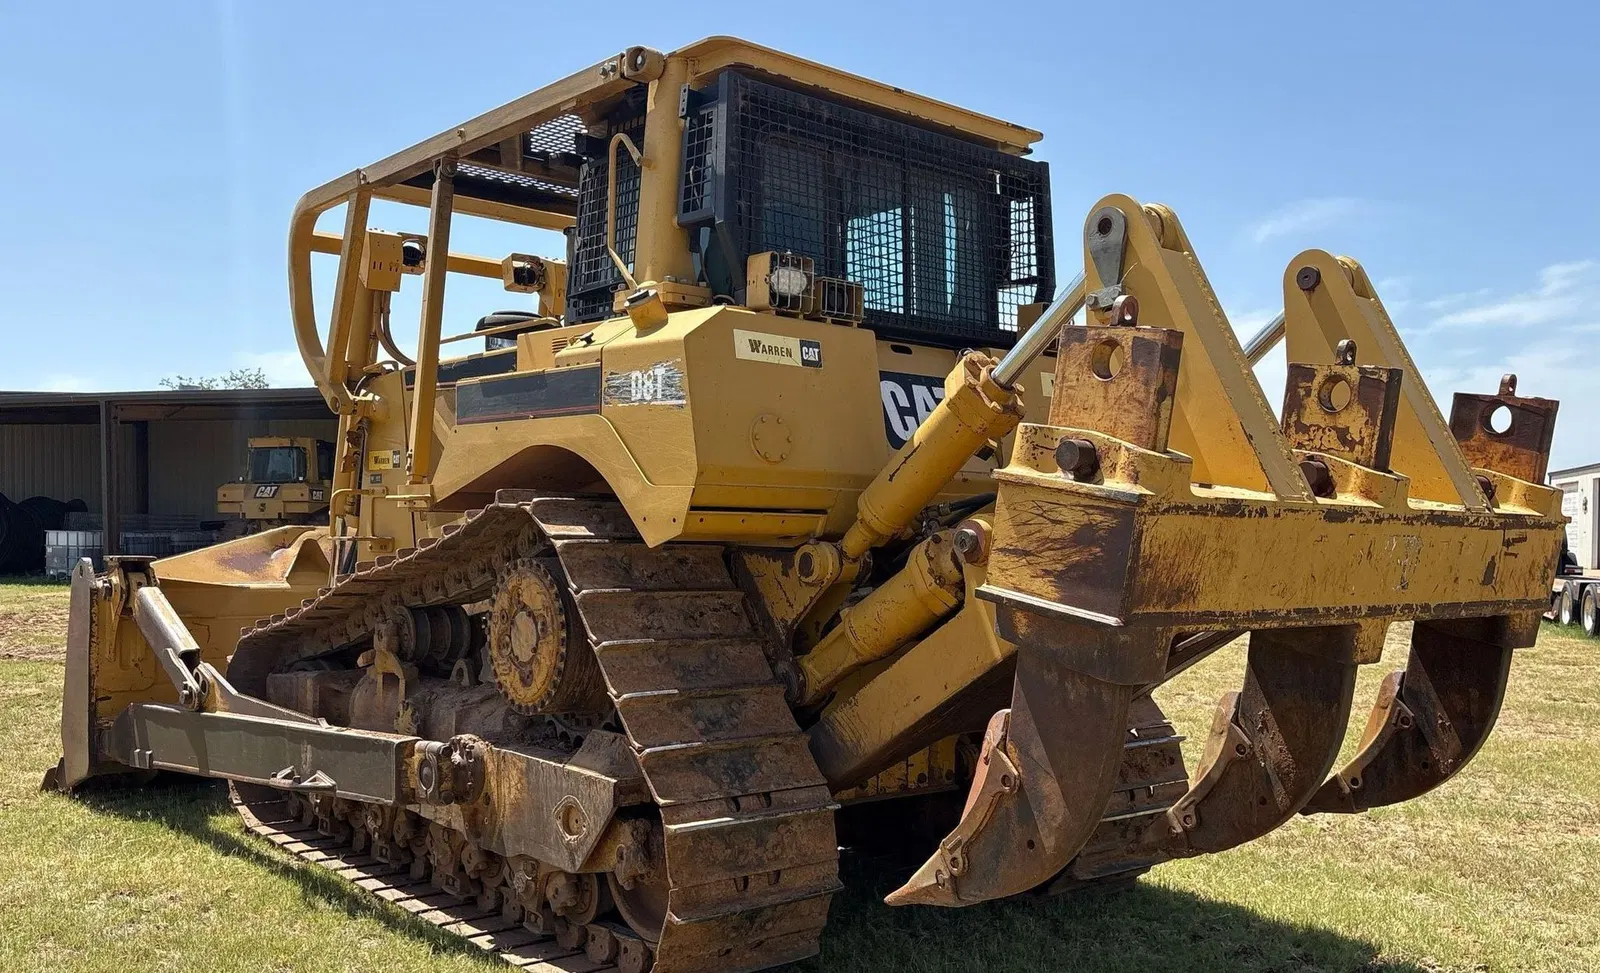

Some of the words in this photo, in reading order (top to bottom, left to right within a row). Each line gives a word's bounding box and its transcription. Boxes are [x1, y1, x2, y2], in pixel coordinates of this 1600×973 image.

[748, 338, 793, 358] WARREN
[802, 346, 819, 361] CAT
[631, 367, 666, 401] D8T
[256, 486, 278, 498] CAT
[312, 491, 323, 500] CAT
